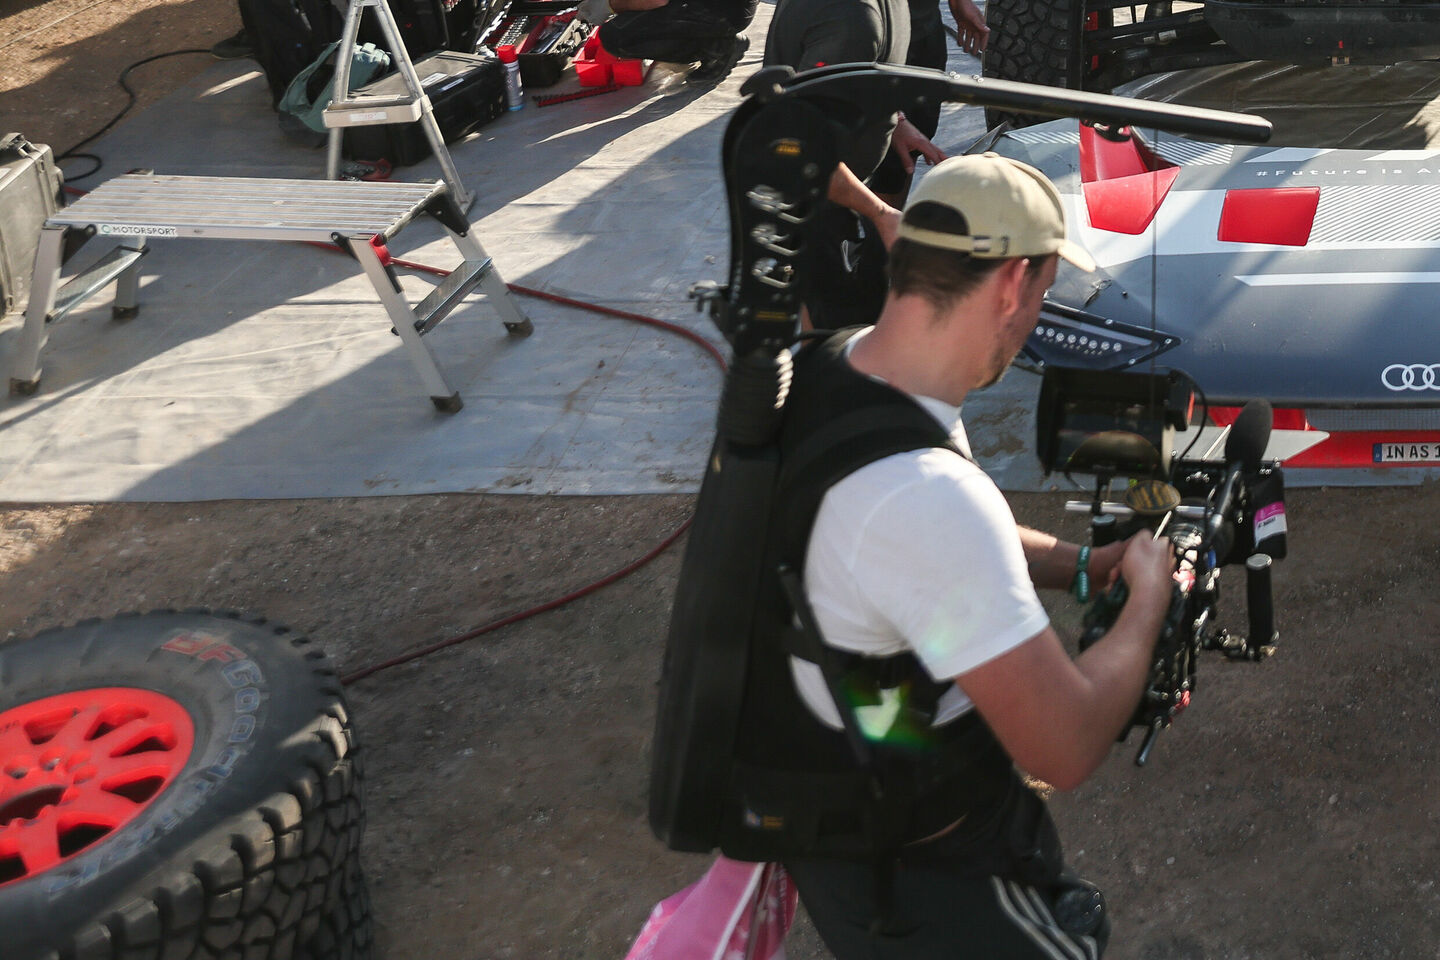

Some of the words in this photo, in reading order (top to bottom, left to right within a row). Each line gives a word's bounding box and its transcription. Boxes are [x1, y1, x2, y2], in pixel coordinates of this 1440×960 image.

[113, 226, 176, 236] MOTORSPORT
[1386, 445, 1405, 459] IN
[1409, 445, 1430, 458] AS
